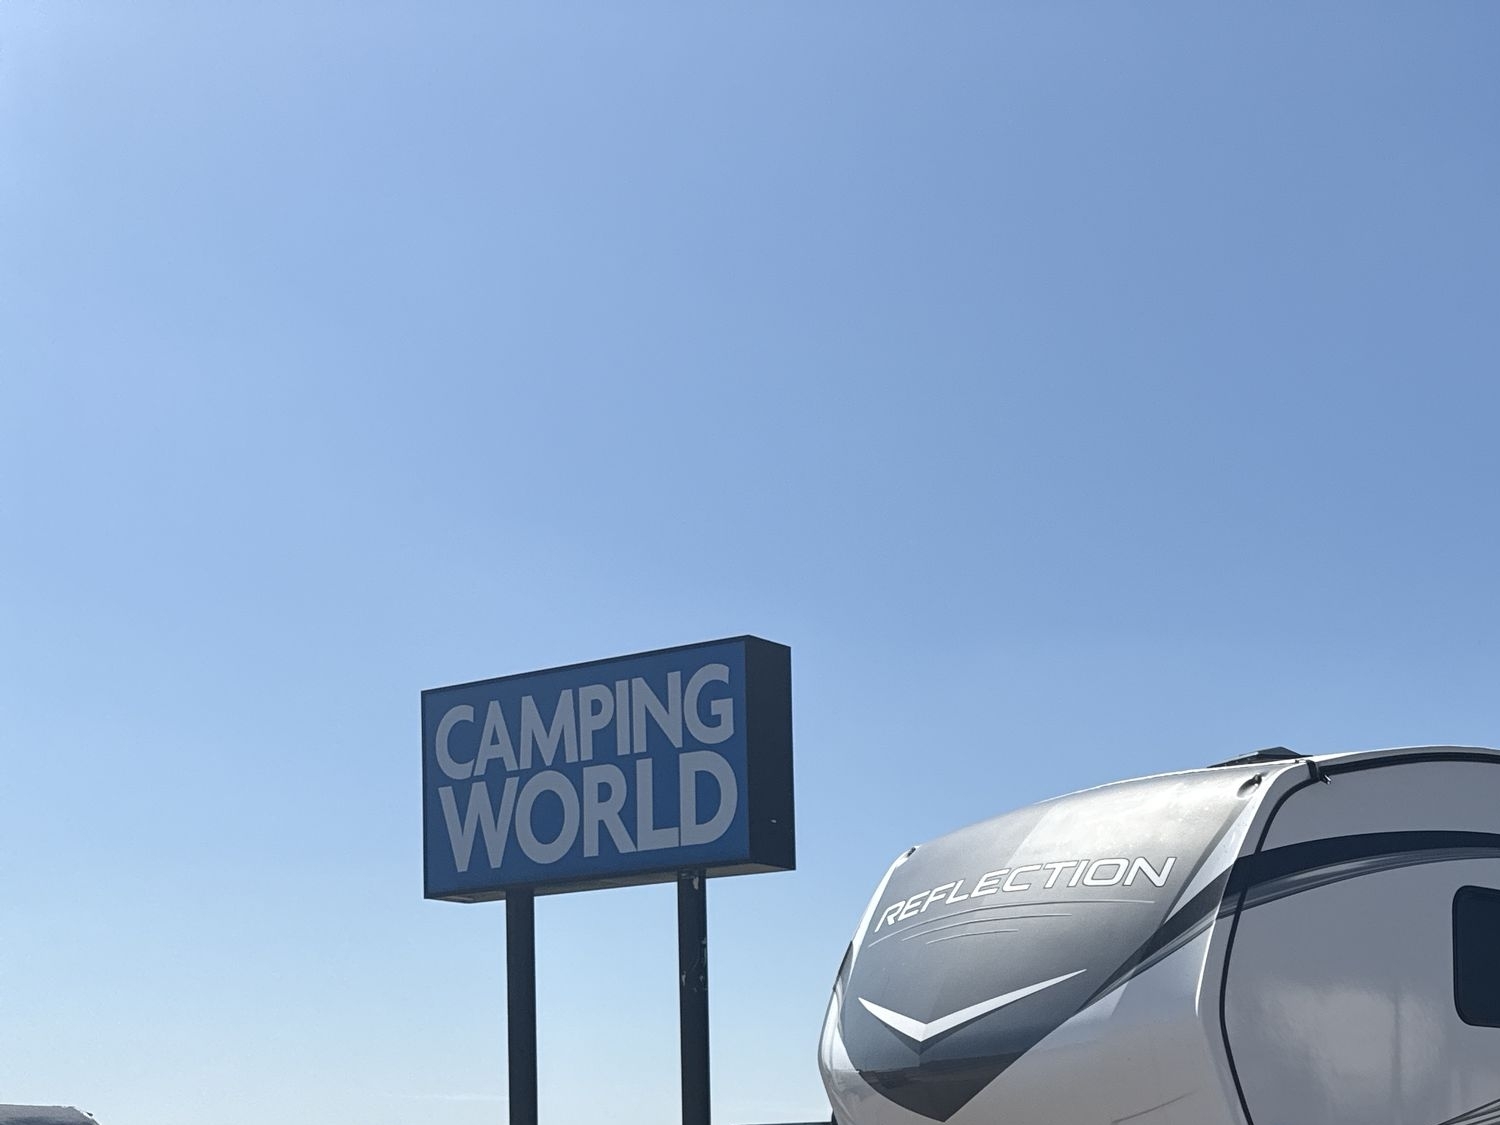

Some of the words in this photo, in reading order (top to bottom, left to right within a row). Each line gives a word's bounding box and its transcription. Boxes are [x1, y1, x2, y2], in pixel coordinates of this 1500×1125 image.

[435, 663, 734, 780] CAMPING
[438, 750, 738, 872] WORLD
[874, 857, 1177, 932] REFLECTION
